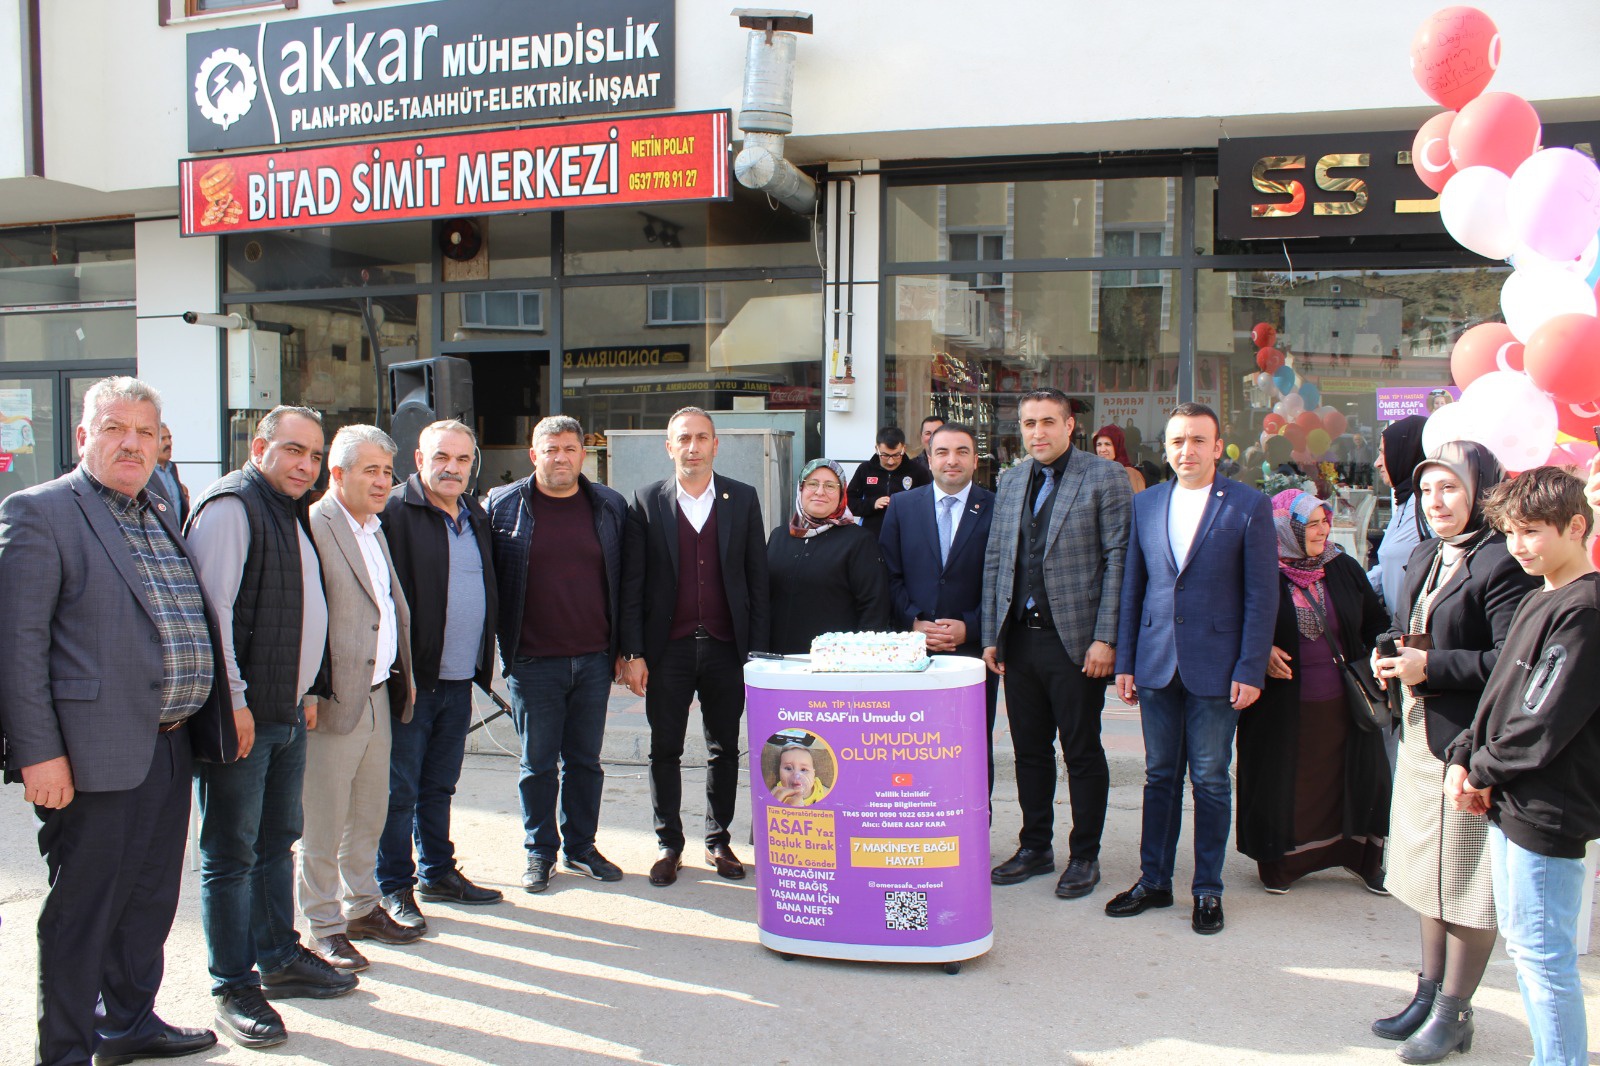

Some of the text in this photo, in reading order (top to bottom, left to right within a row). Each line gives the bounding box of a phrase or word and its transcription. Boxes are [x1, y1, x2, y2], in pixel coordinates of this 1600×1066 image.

[279, 17, 660, 96] akkar MÜHENDİSLİK
[291, 73, 660, 131] PLAN-PROJE-TAAHHÜT-ELEKTRİK-İNŞAAT
[631, 135, 695, 157] METİN POLAT
[248, 126, 619, 221] BİTAD SİMİT MERKEZİ
[629, 170, 697, 190] 0537 778 91 27
[1379, 401, 1399, 409] ÖMER
[808, 699, 891, 709] SMA TİP 1 HASTASI
[777, 708, 924, 723] ÖMER ASAF'ın Umudu Ol
[861, 731, 941, 746] UMUDUM
[841, 745, 962, 761] OLUR MUSUN?
[900, 790, 930, 798] İzinlidir
[894, 801, 937, 809] Bilgilerimiz
[781, 809, 833, 818] Operatörlerden
[769, 818, 834, 837] ASAF Yaz
[881, 820, 903, 828] ÖMER
[925, 820, 946, 828] KARA
[769, 836, 834, 851] Boşluk Bırak
[853, 840, 956, 853] 7 MAKİNEYE BAĞLI
[804, 859, 835, 868] Gönder
[885, 856, 924, 866] HAYAT!
[771, 866, 836, 881] YAPACAĞINIZ
[778, 879, 828, 892] HER BAĞIŞ
[770, 888, 840, 904] YAŞAMAM İÇİN
[776, 901, 833, 916] BANA NEFES
[783, 914, 825, 927] OLACAK!
